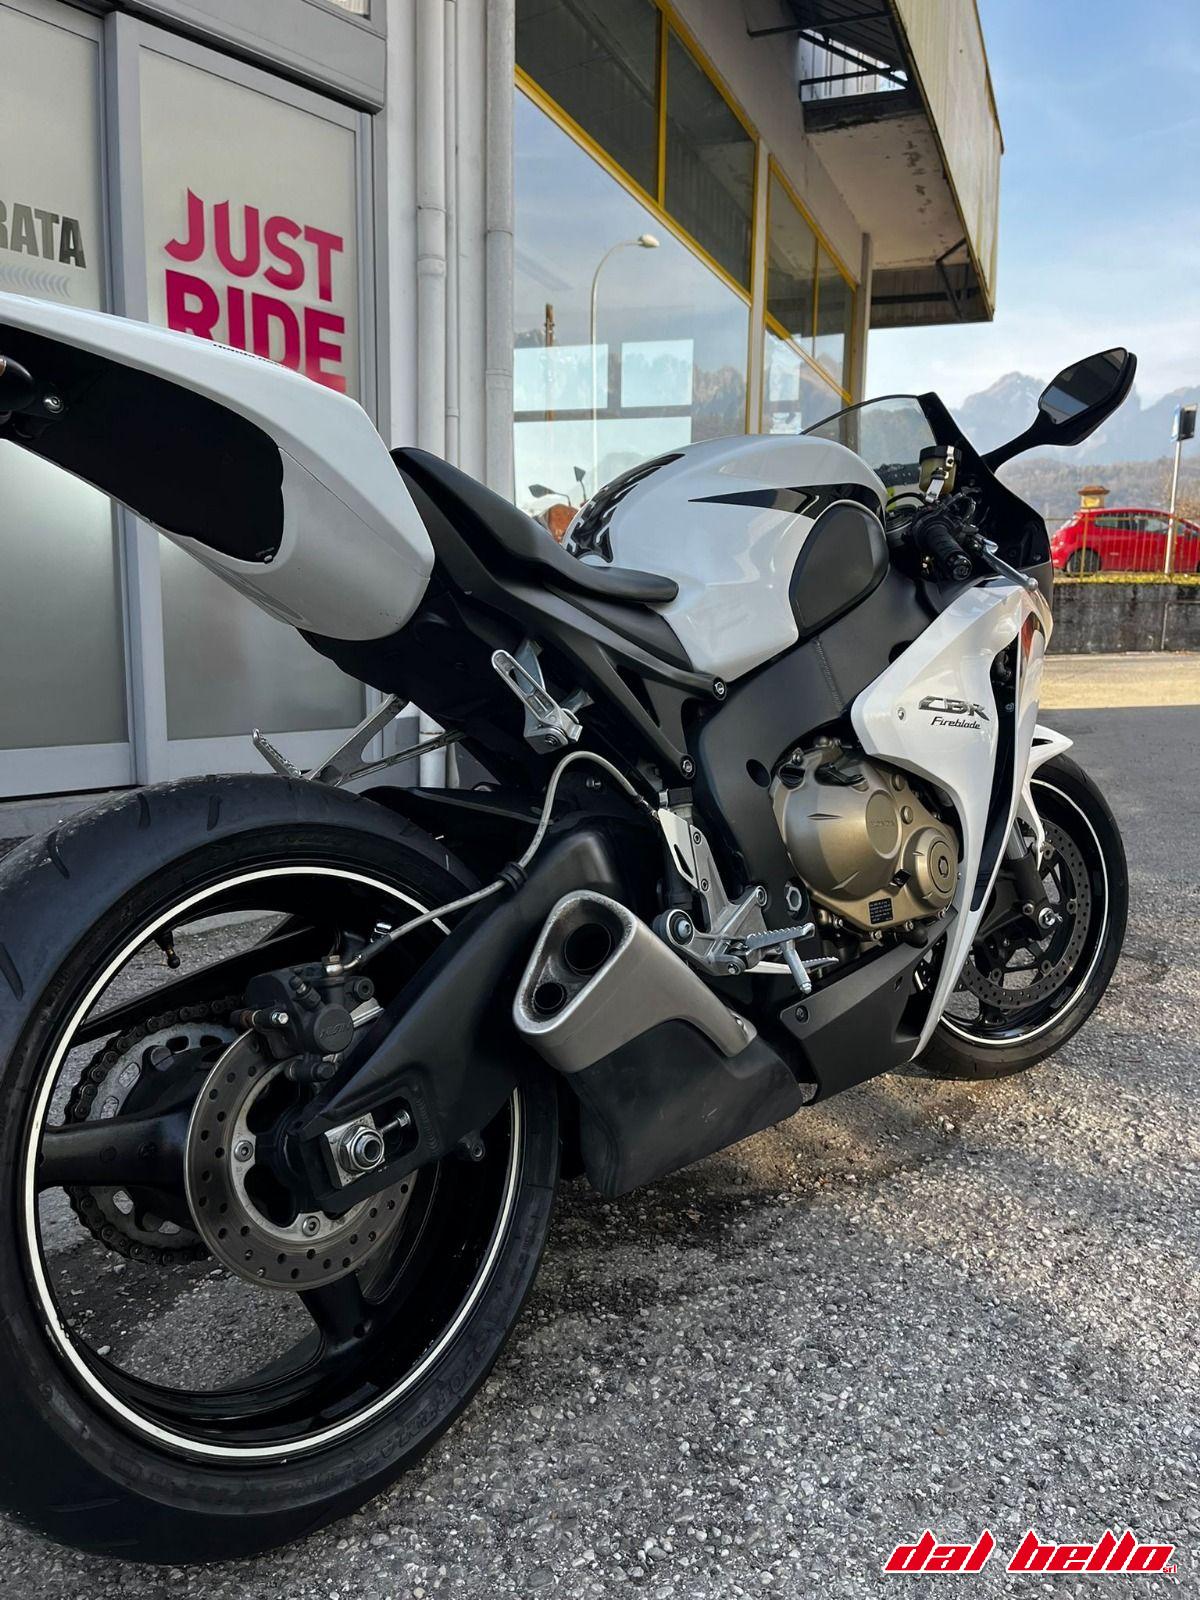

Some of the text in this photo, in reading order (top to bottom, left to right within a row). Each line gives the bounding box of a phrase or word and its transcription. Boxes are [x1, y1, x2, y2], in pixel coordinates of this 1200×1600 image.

[164, 187, 343, 302] JUST
[165, 269, 346, 393] RIDE
[919, 696, 990, 721] CBR
[931, 716, 981, 730] Fireblade
